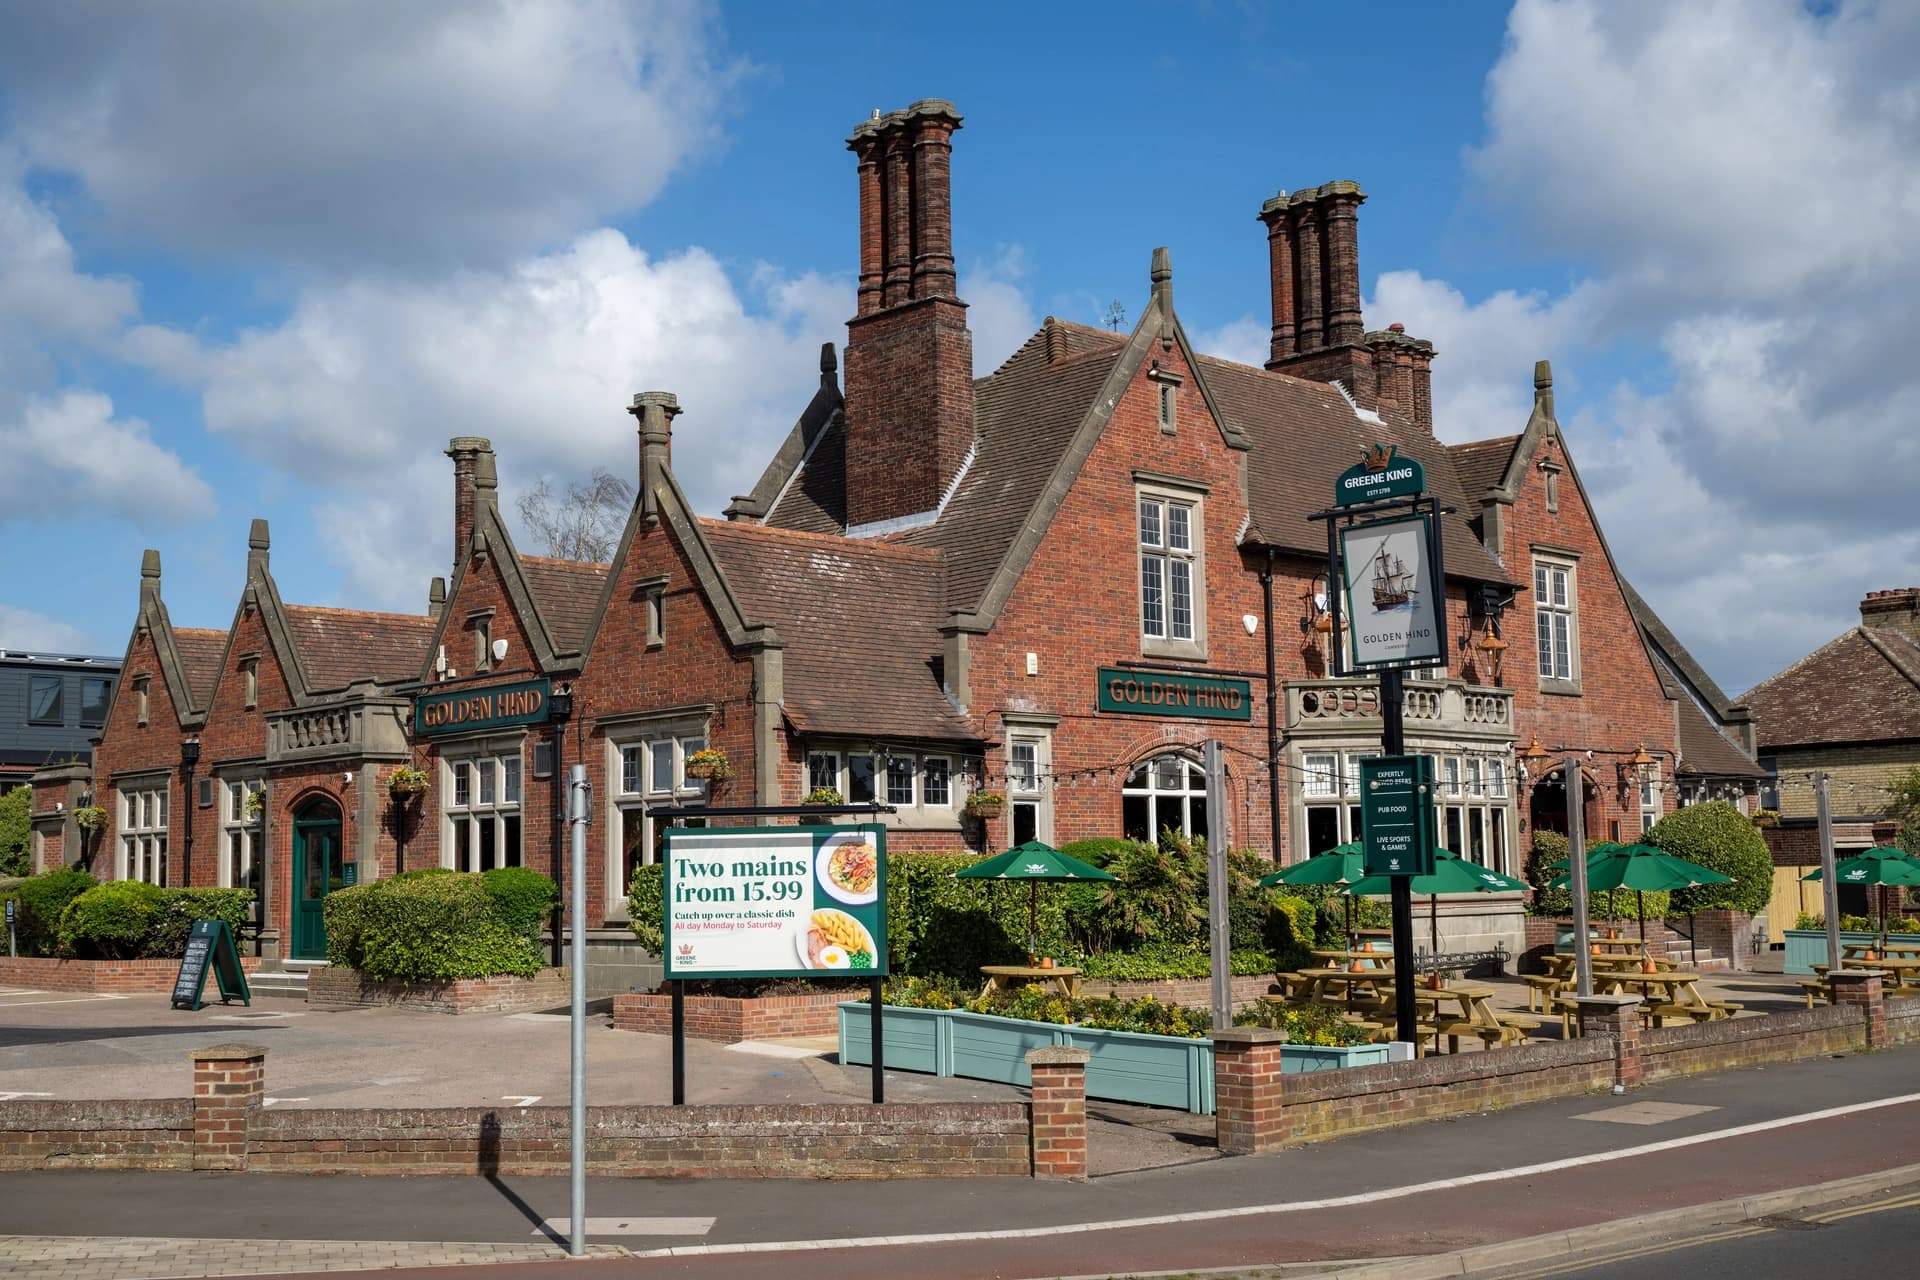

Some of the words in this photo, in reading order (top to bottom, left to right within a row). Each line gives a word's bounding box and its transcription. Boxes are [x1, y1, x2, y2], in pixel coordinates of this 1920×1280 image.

[1345, 473, 1385, 488] GREENE
[1386, 468, 1413, 481] KING
[1363, 632, 1402, 644] GOLDEN
[1406, 628, 1430, 639] HIND
[1110, 679, 1189, 707] GOLDEN
[1196, 685, 1242, 710] HIND
[424, 695, 492, 727] GOLDEN
[497, 690, 542, 718] HIND
[675, 858, 724, 878] Two
[732, 855, 807, 876] mains
[676, 882, 735, 902] from
[743, 881, 803, 901] 15.99
[744, 910, 774, 919] classic
[776, 909, 795, 918] dish
[687, 922, 701, 931] day
[704, 922, 735, 930] Monday
[747, 921, 782, 929] Saturday
